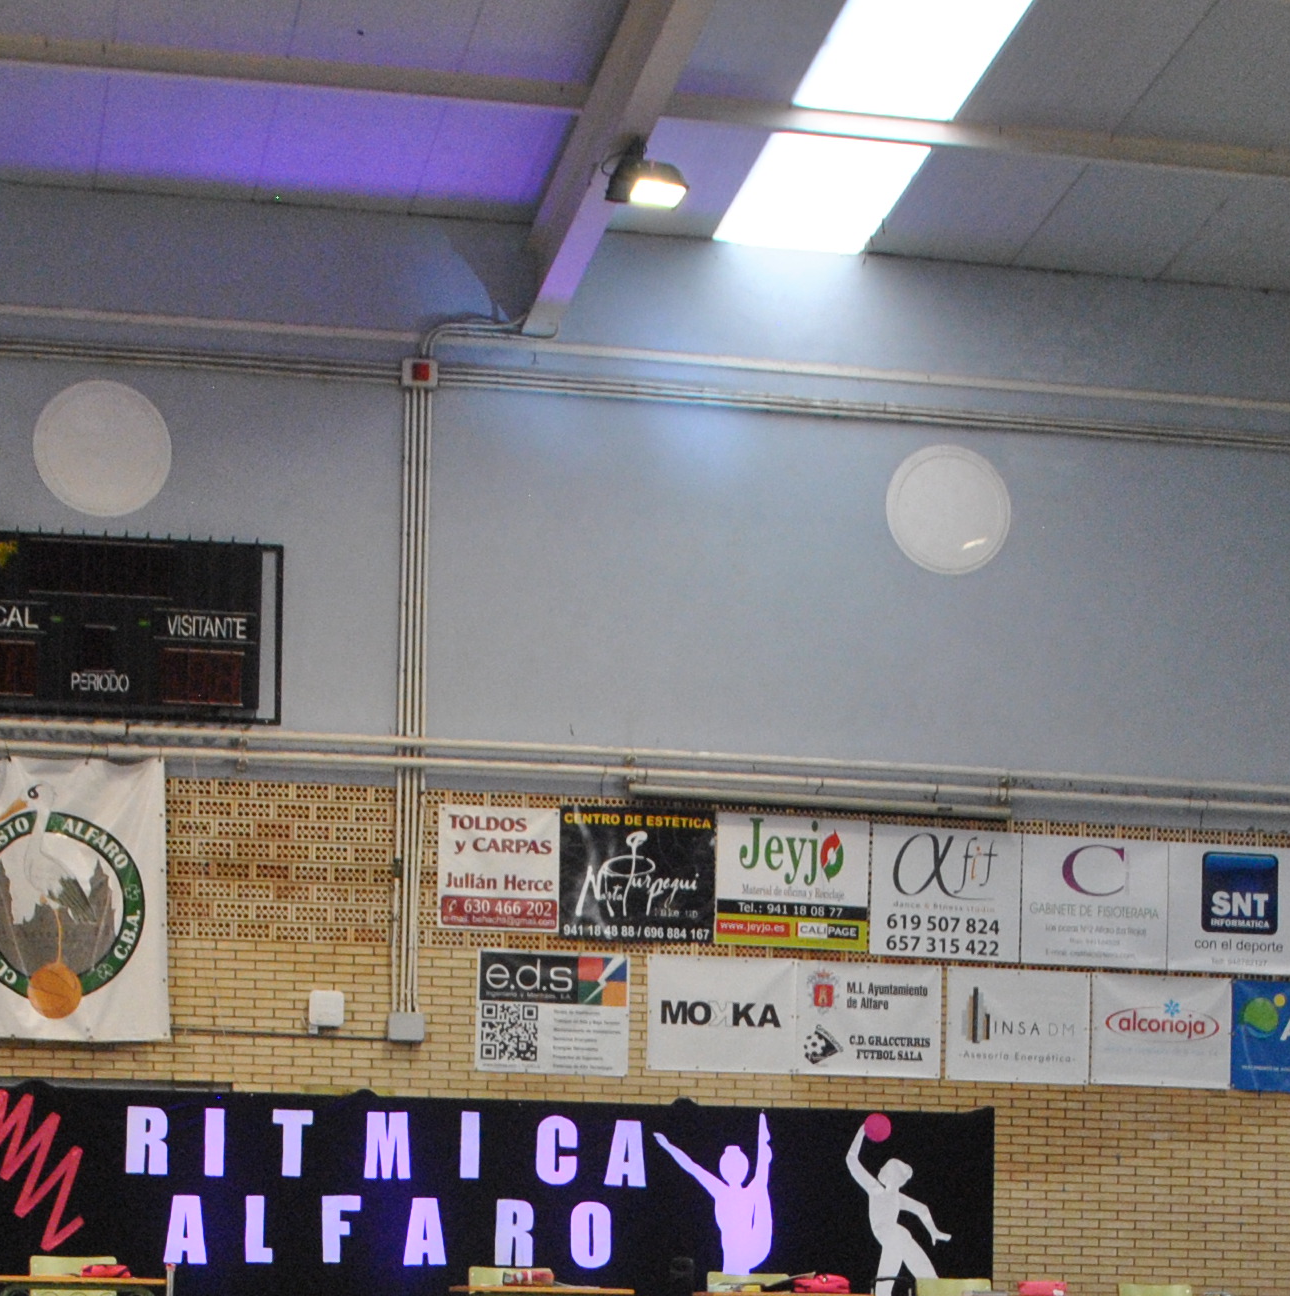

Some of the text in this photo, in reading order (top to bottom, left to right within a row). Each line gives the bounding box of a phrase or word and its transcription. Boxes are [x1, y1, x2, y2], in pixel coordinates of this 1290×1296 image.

[167, 615, 247, 639] VISITANTE
[71, 672, 129, 693] PERIODO
[449, 814, 527, 832] TOLDOS
[564, 813, 621, 826] CENTRO
[624, 814, 643, 826] DE
[62, 818, 130, 869] ALFARO
[455, 837, 552, 855] y CARPAS
[446, 872, 553, 891] Julián Herce
[463, 899, 552, 916] 630 466 202
[738, 902, 843, 918] Tel.: 941 18 08 77
[1029, 901, 1159, 920] GABINETE DE FISIOTERAPIA
[1211, 890, 1269, 918] SNT
[563, 925, 584, 936] 941
[589, 925, 601, 936] 18
[604, 925, 618, 937] 48
[621, 926, 635, 937] 88
[644, 926, 664, 938] 696
[666, 927, 687, 939] 884
[690, 928, 710, 940] 167
[720, 920, 785, 933] www.jeyjo.es
[886, 913, 1000, 935] 619 507 824
[114, 909, 142, 960] C.B.A.
[886, 935, 999, 957] 657 315 422
[1194, 939, 1284, 954] con el deporte
[847, 982, 928, 997] M.I. Ayuntamiento
[847, 997, 889, 1010] de Alfaro
[849, 1035, 931, 1048] C.D. GRACCURRIS
[897, 1050, 923, 1061] SALA
[125, 1105, 647, 1188] RITMICA
[163, 1194, 612, 1269] ALFARO
